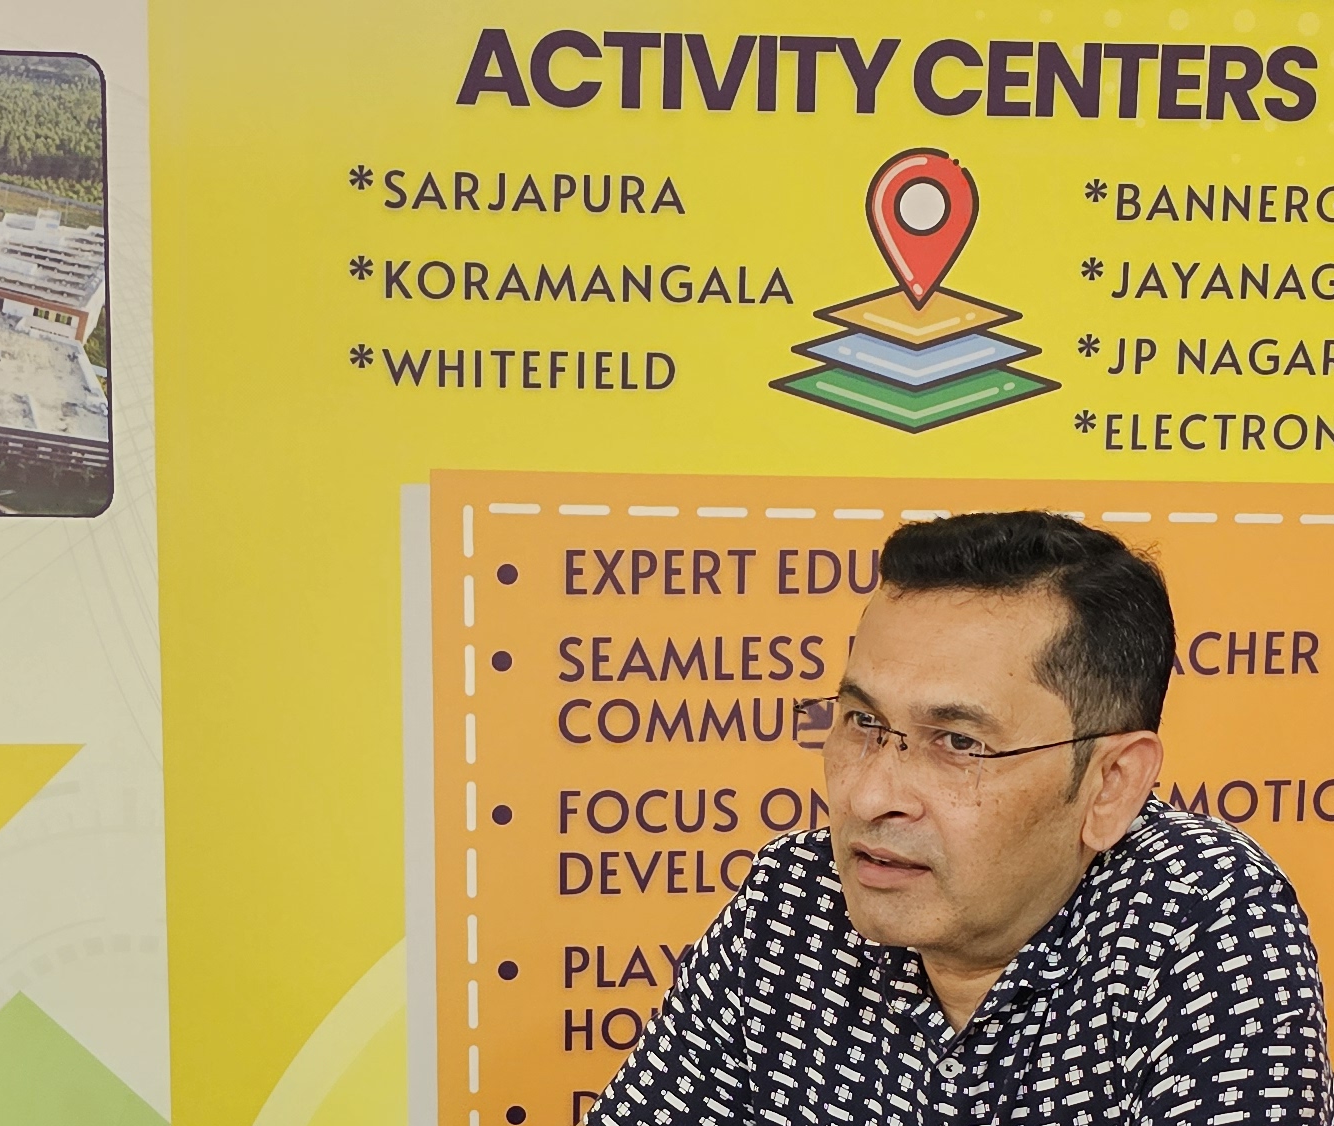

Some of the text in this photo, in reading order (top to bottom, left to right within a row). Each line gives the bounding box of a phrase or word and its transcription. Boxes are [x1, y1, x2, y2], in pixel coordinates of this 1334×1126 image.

[455, 28, 1319, 122] ACTIVITY CENTERS
[565, 548, 758, 596] EXPERT
[558, 634, 826, 683] SEAMLESS
[558, 697, 800, 744] COMMU
[559, 787, 740, 835] FOCUS
[564, 1007, 663, 1052] HO
